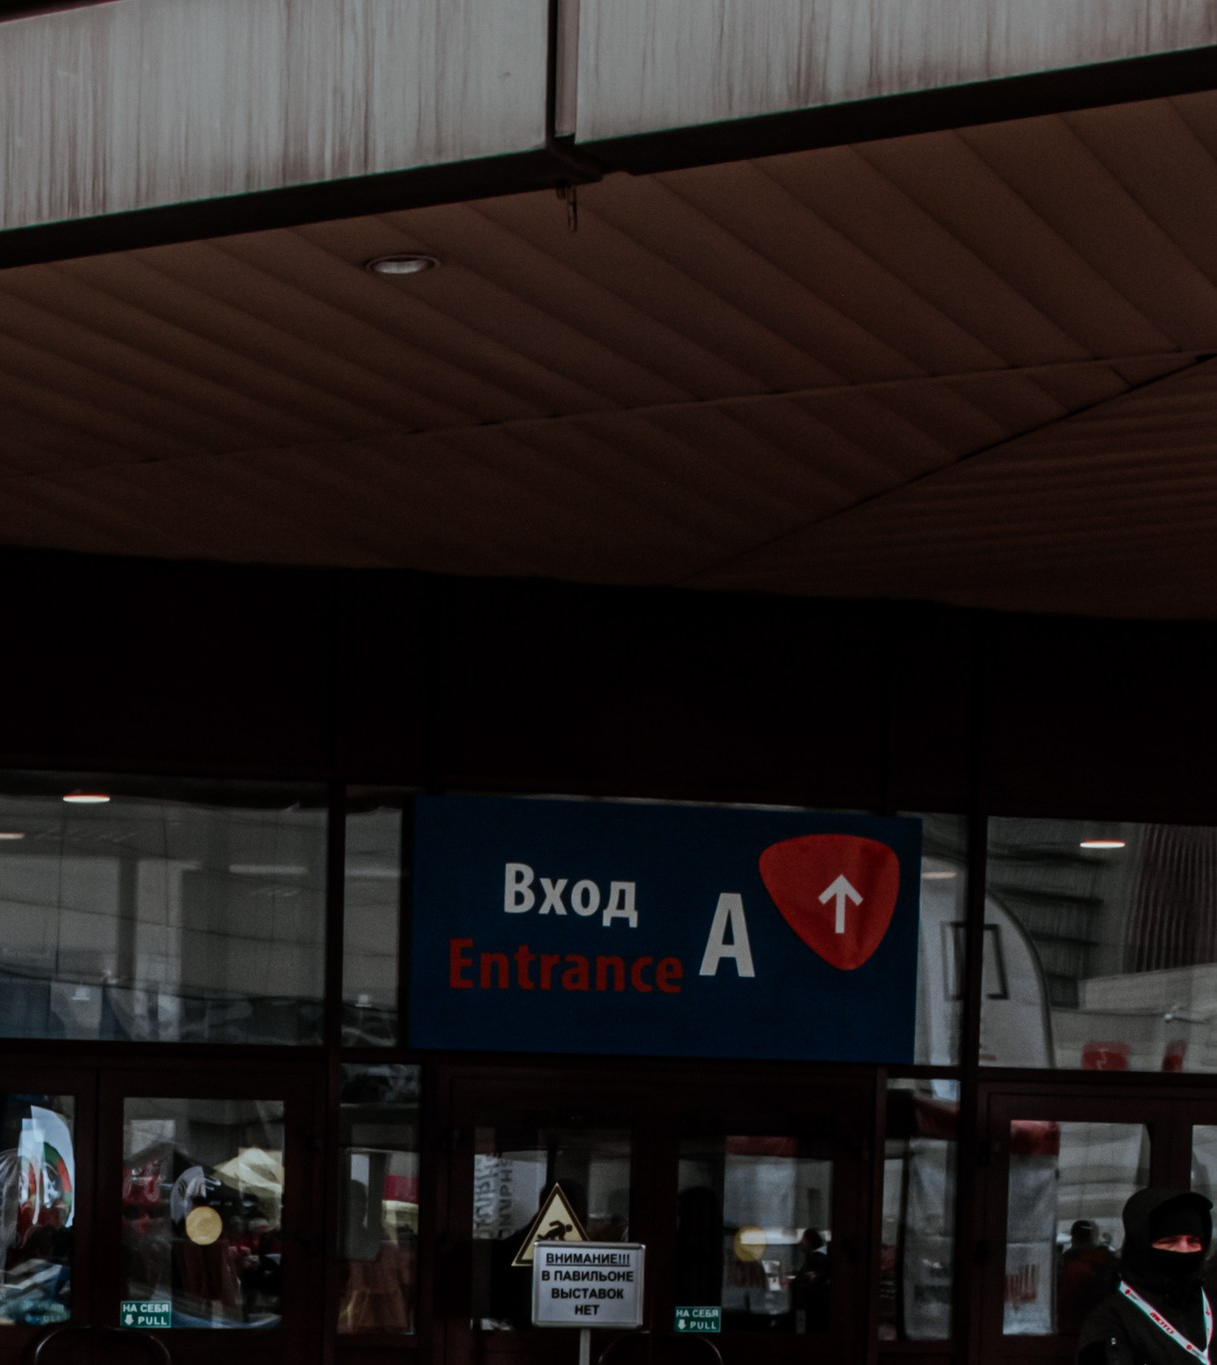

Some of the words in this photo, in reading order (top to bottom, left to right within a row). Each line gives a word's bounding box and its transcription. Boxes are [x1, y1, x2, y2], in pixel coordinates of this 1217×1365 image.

[503, 861, 638, 928] Вход
[449, 937, 683, 996] Entrance
[546, 1253, 630, 1266] ВНИМАНИЕ!!!
[542, 1271, 550, 1281] В
[554, 1271, 634, 1282] ПАВИЛЬОНЕ
[551, 1287, 624, 1299] ВЫСТАВОК
[122, 1304, 137, 1313] НА
[140, 1304, 169, 1313] СЕБЯ
[574, 1305, 600, 1316] НЕТ
[675, 1309, 690, 1318] НА
[692, 1309, 719, 1318] СЕБЯ
[137, 1316, 168, 1326] PULL
[690, 1320, 717, 1330] PULL
